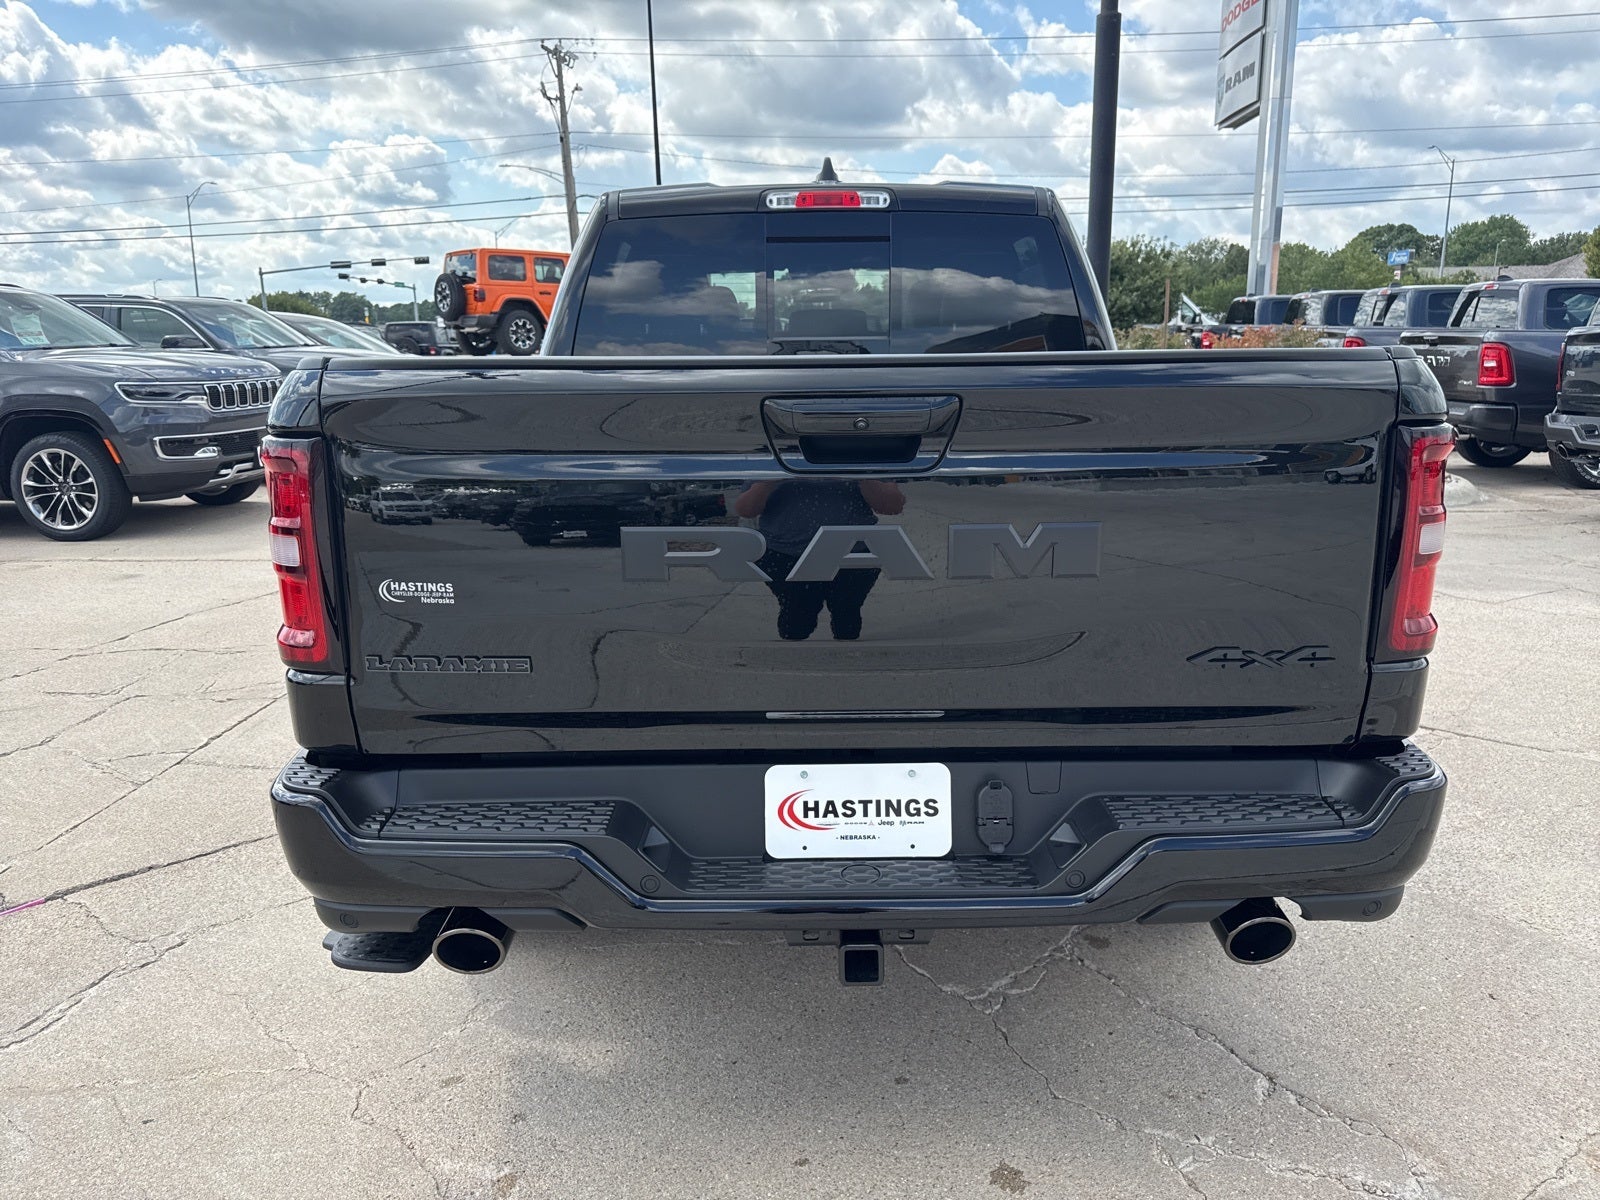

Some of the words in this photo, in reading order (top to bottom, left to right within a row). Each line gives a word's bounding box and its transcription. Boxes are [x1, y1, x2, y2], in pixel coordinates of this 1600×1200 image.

[1225, 61, 1256, 94] RAM
[620, 521, 1103, 582] RAM
[390, 581, 454, 592] HASTINGS
[421, 596, 455, 604] Nebraska
[365, 655, 533, 674] LARAMIE
[802, 798, 939, 819] HASTINGS
[877, 819, 895, 827] Jeep
